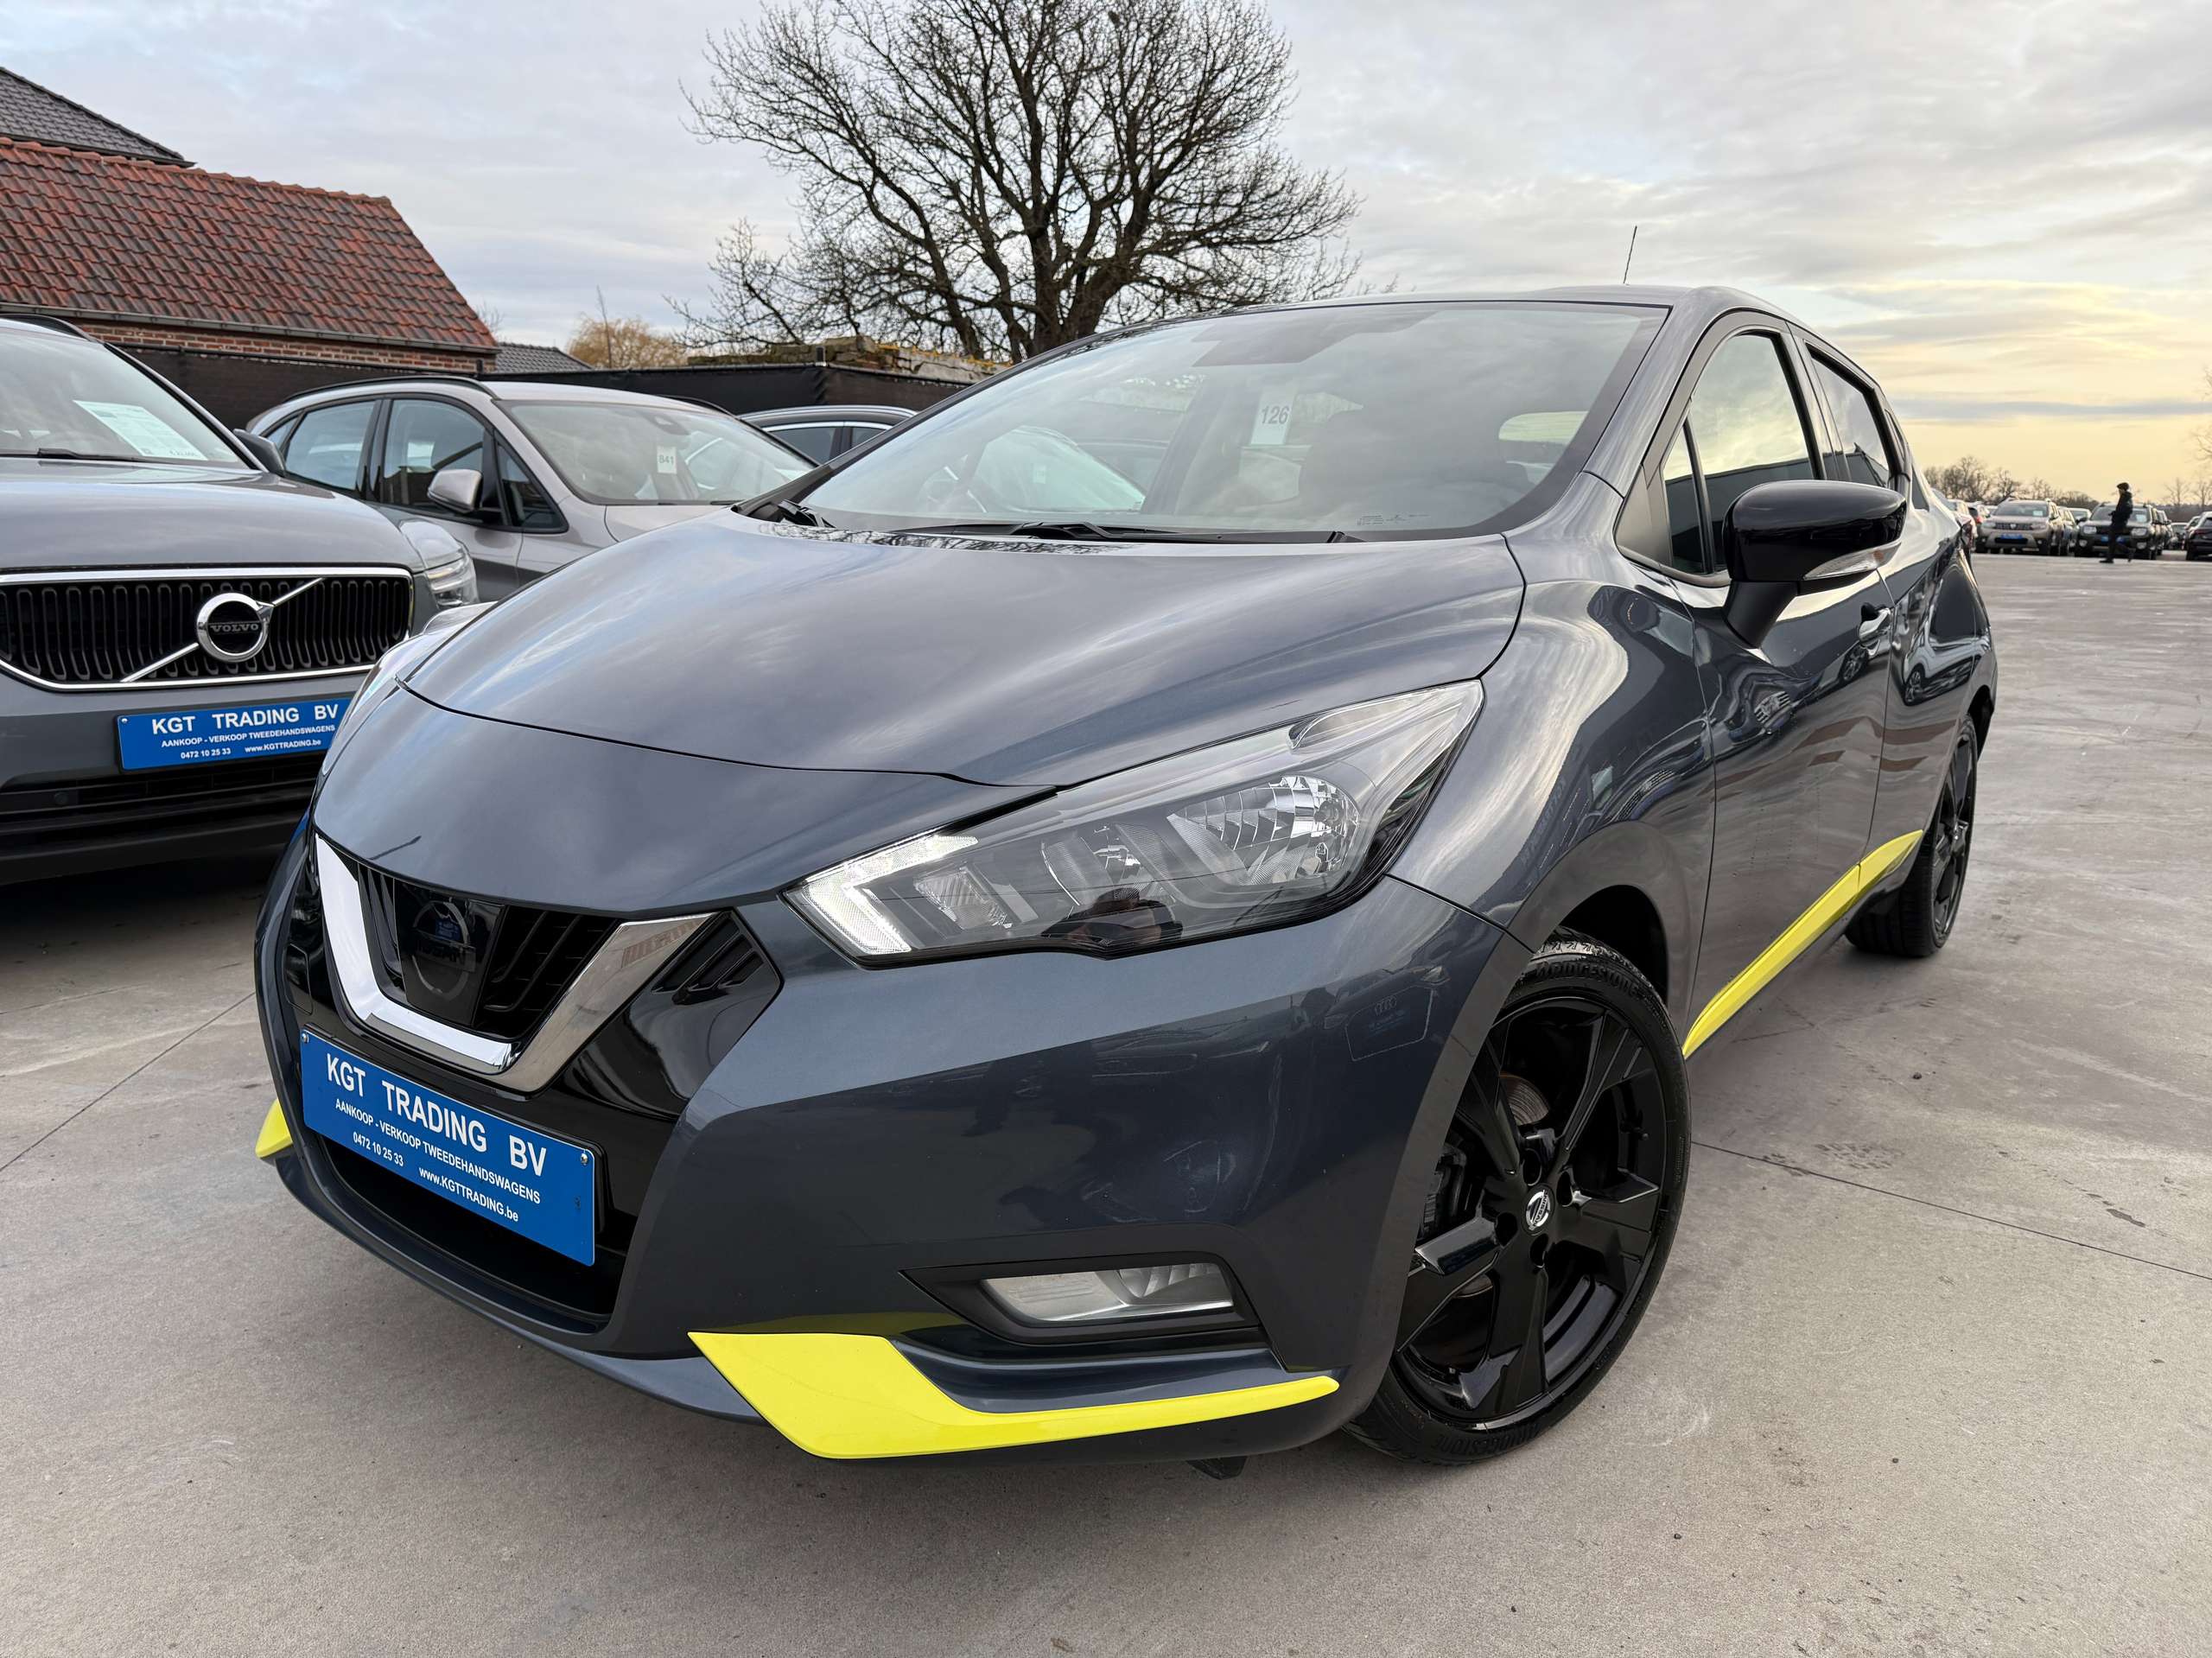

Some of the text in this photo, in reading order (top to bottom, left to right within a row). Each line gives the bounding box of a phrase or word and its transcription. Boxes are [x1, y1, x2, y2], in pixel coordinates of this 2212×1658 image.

[1262, 405, 1289, 424] 126
[210, 623, 259, 632] VOLVO
[152, 704, 339, 734] KGT TRADING BV
[162, 737, 203, 747] AANKOOP
[208, 733, 248, 743] VERKOOP
[249, 725, 335, 740] TWEEDEHANDSWAGENS
[181, 751, 200, 759] 0472
[245, 739, 321, 753] www.KGTTRADING.be
[327, 1052, 547, 1177] KGT TRADING BV
[335, 1098, 373, 1126] AANKOOP
[379, 1120, 422, 1150] VERKOOP
[423, 1140, 541, 1204] TWEEDEHANDSWAGENS
[353, 1131, 519, 1222] 0472 10 25 33 www.KGTTRADING.be
